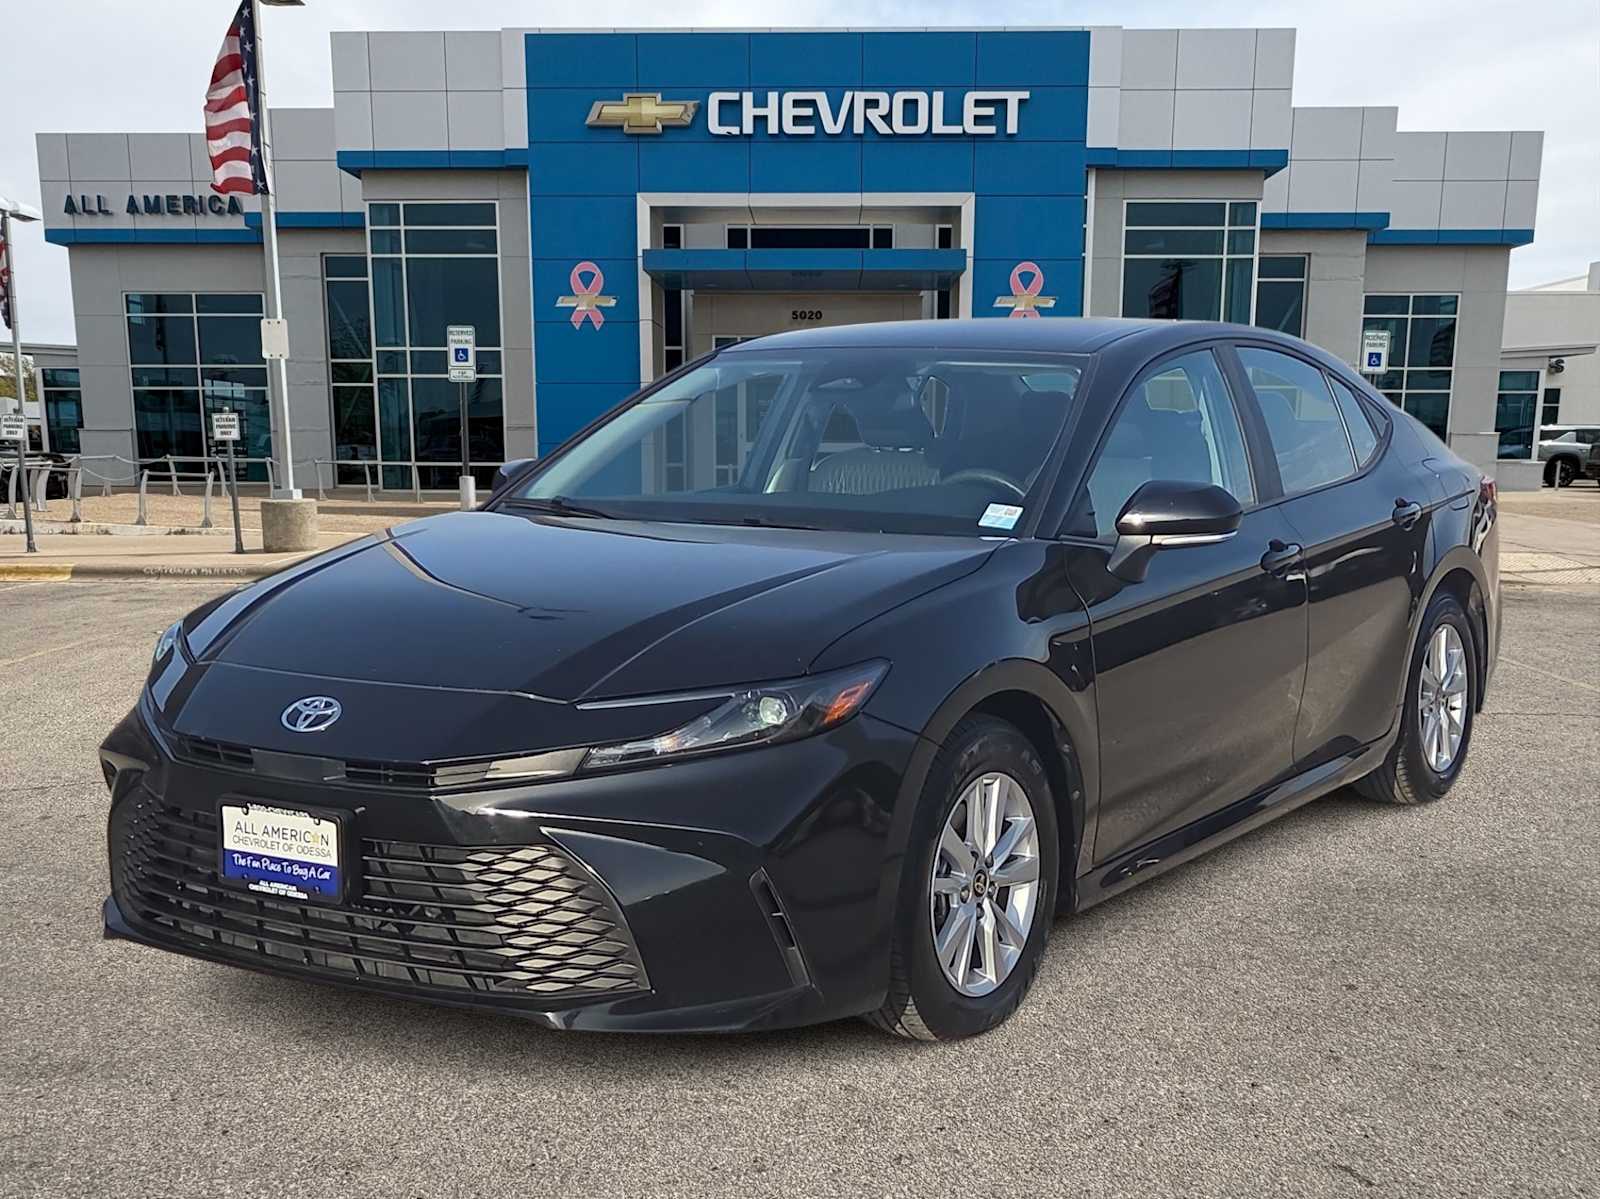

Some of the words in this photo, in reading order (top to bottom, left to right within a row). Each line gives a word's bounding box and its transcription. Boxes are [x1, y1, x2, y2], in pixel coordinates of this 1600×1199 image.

[708, 91, 1030, 135] CHEVROLET
[64, 195, 112, 215] ALL
[791, 310, 823, 320] 5020
[234, 820, 258, 836] ALL
[232, 834, 281, 851] CHEVROLET
[282, 842, 294, 853] OF
[296, 845, 332, 858] ODESSA
[232, 853, 246, 866] The
[247, 856, 261, 868] Fun
[261, 857, 281, 873] Place
[281, 861, 292, 874] To
[292, 863, 309, 880] Buy
[308, 866, 317, 878] A
[317, 868, 332, 880] Car
